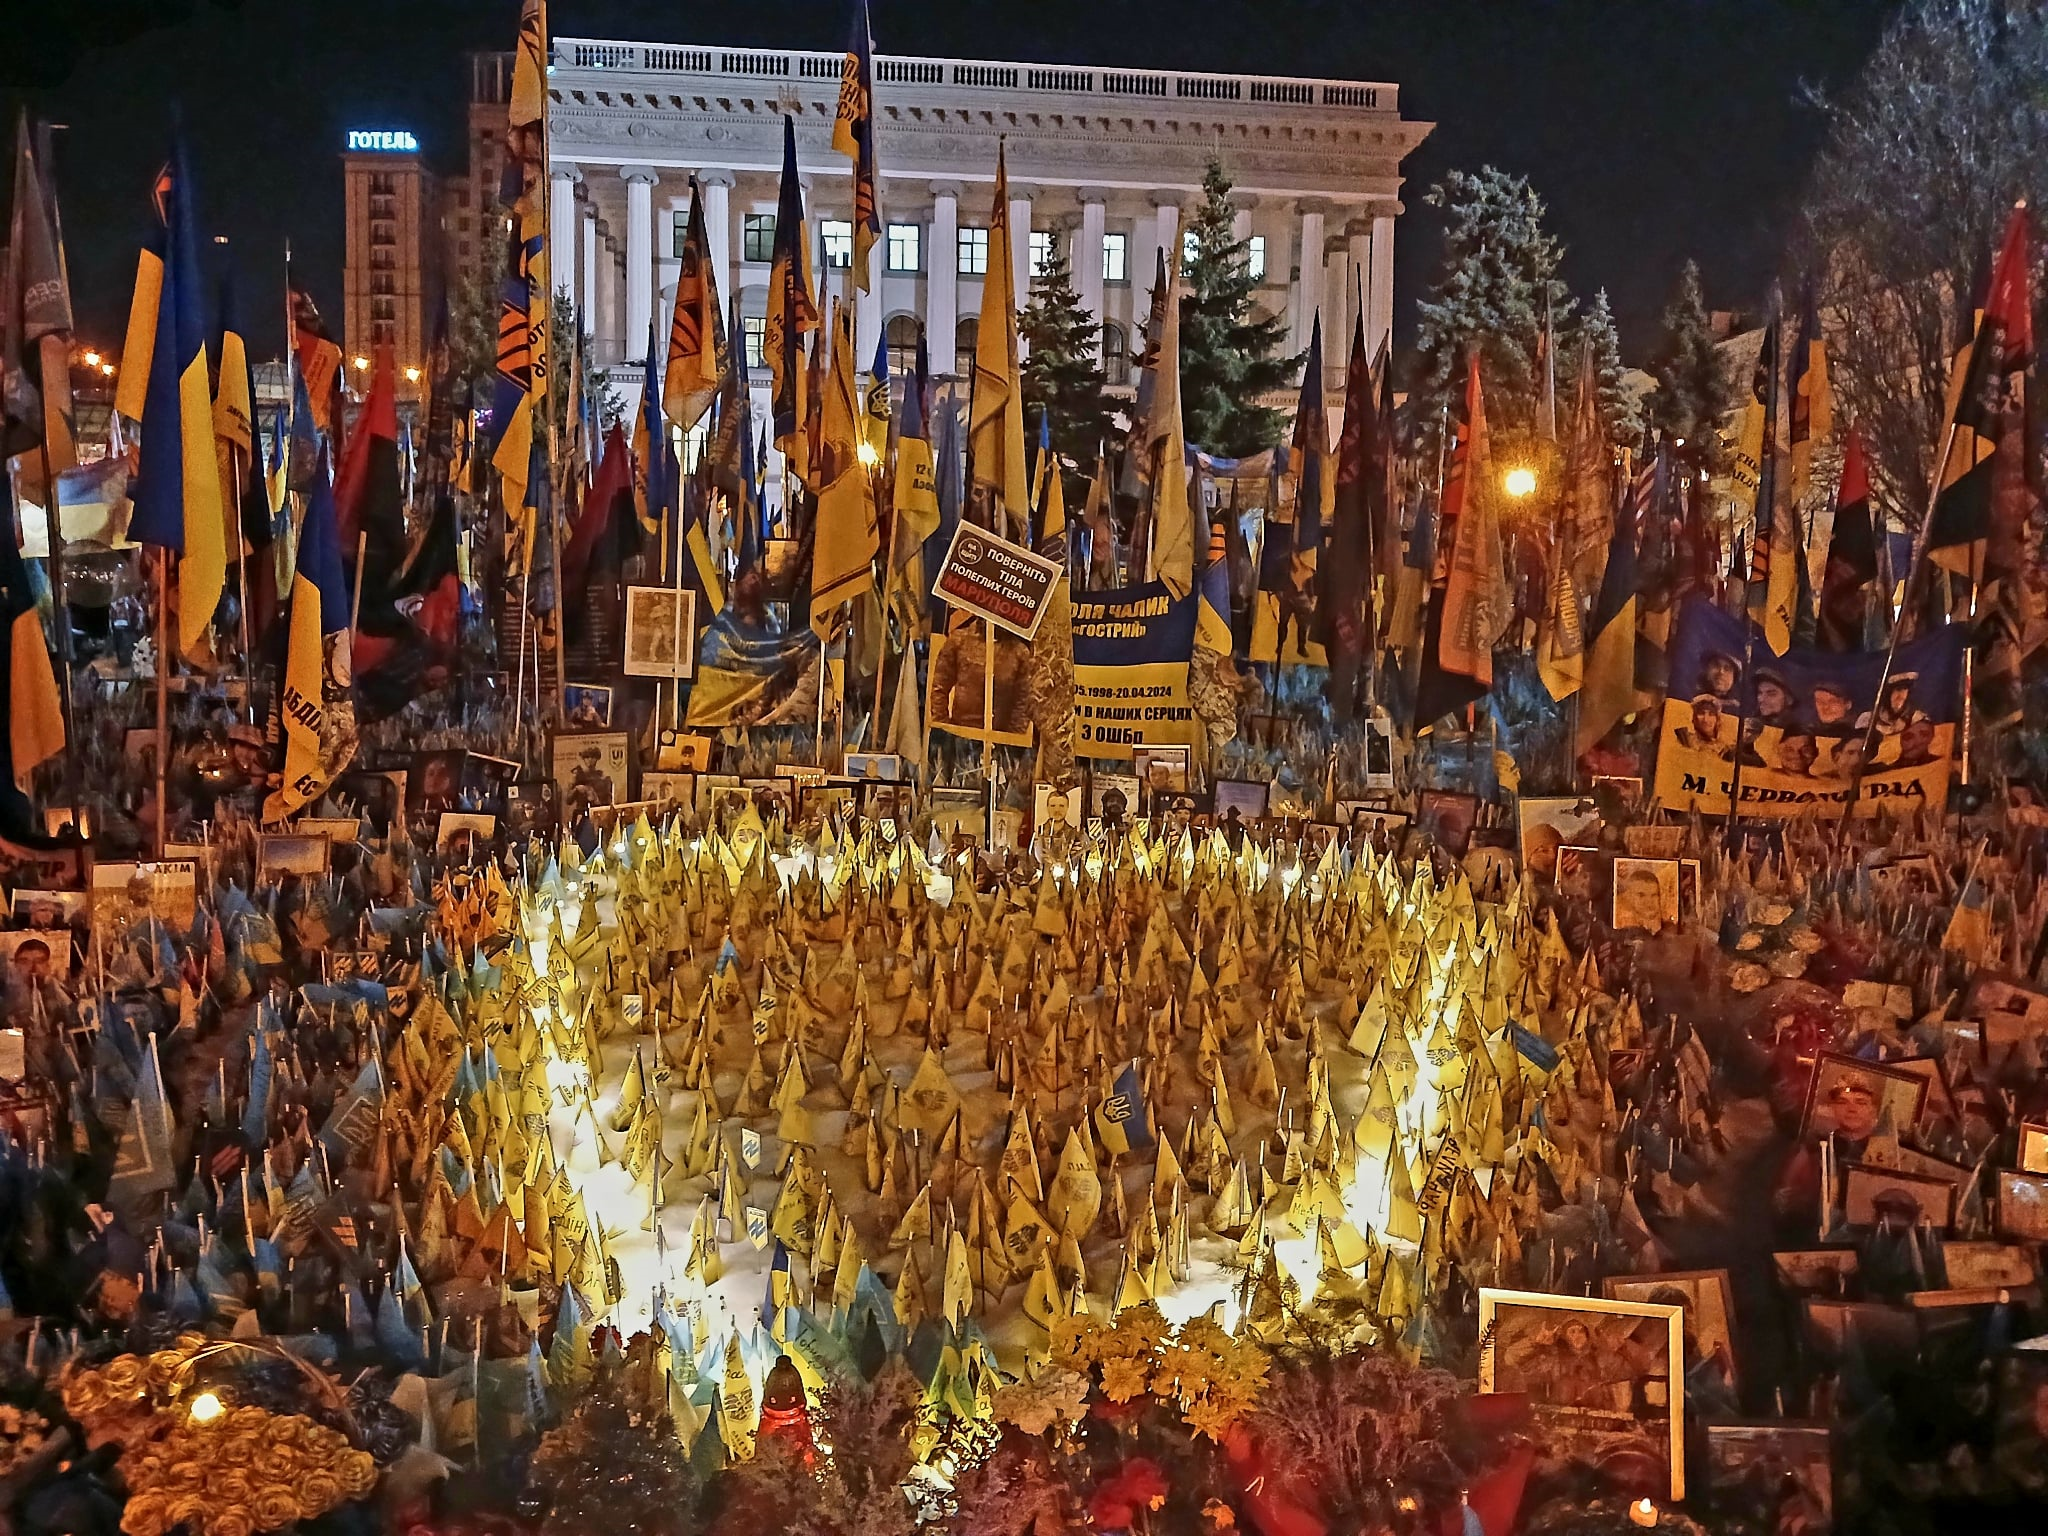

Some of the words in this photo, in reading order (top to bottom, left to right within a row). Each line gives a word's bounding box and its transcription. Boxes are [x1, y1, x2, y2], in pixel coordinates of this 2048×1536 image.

[348, 131, 417, 149] ГОТЕЛЬ
[987, 548, 1047, 584] ПОВЕРНІТЬ
[950, 562, 1000, 593] ПОЛЕГЛИХ
[1001, 587, 1037, 609] ГЕРОЇВ
[999, 569, 1023, 589] ТІЛА
[944, 574, 1032, 625] МАРІУПОЛЯ
[1070, 602, 1105, 619] ОЛЯ
[1109, 596, 1170, 618] ЧАЛИК
[1085, 705, 1092, 718] В
[1096, 706, 1142, 720] НАШИХ
[1145, 706, 1193, 722] СЕРЦЯХ
[1682, 773, 1711, 797] М.
